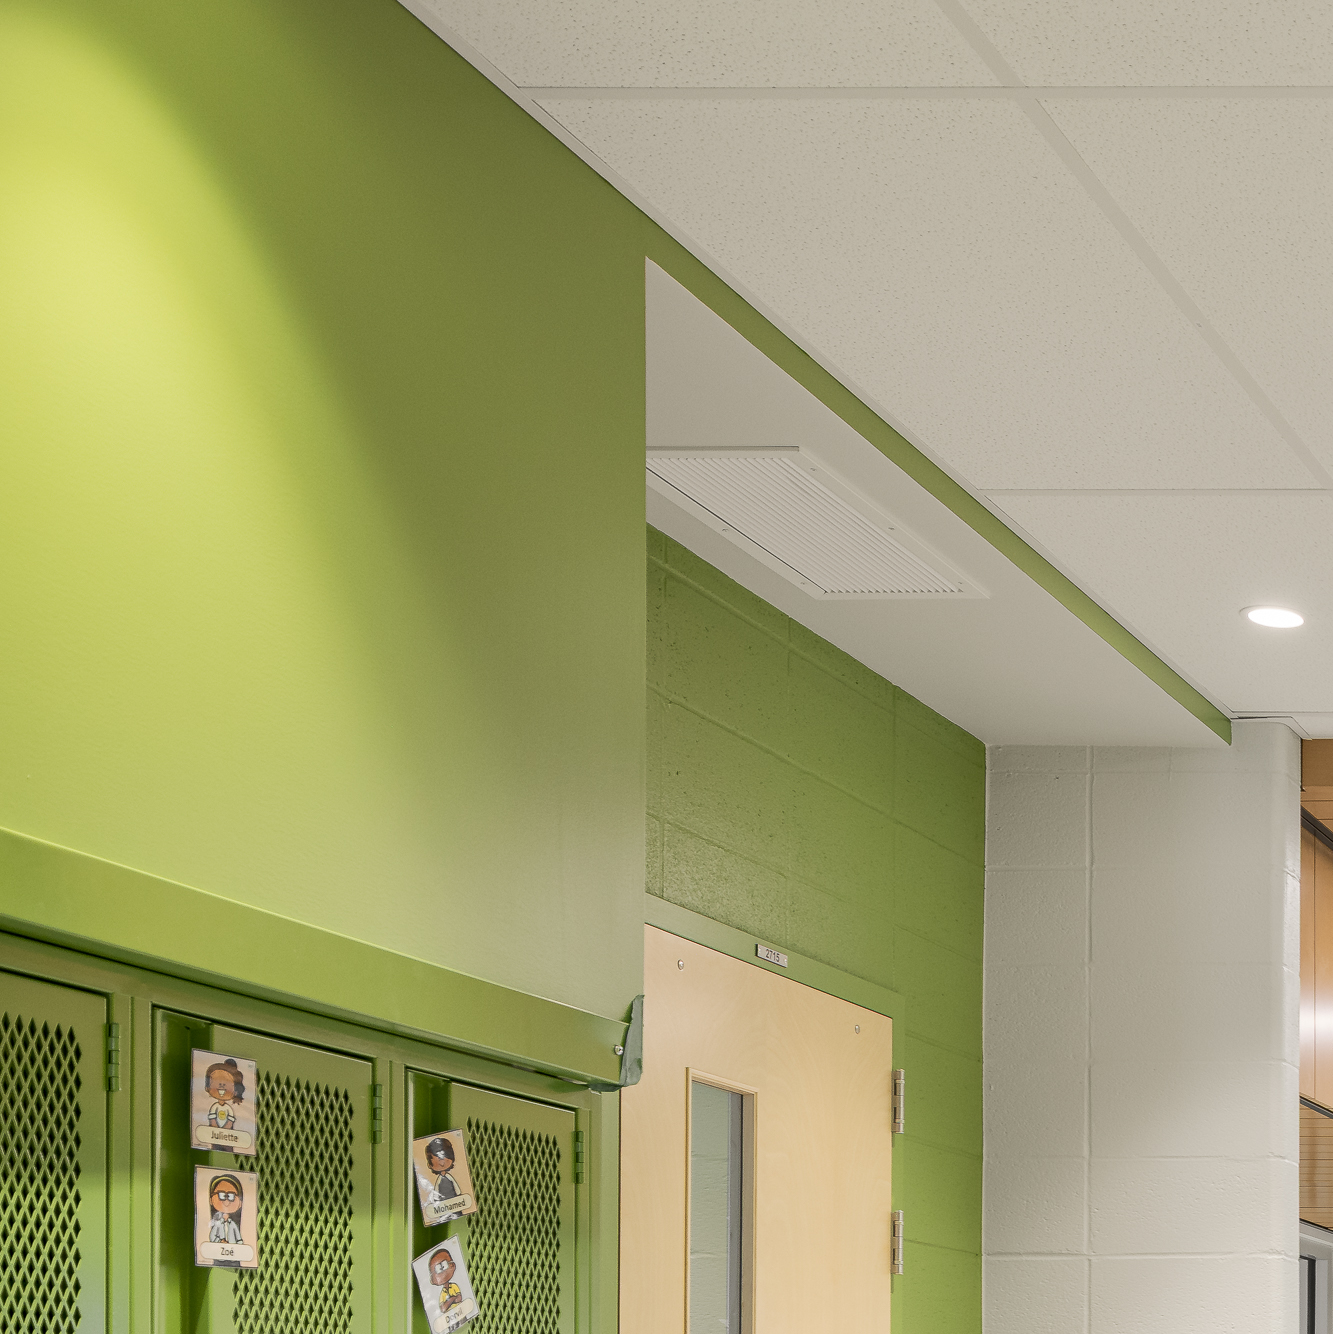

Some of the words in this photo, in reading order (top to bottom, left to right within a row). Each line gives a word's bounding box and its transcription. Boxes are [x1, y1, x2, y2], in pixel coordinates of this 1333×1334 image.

[766, 949, 780, 962] 2715
[211, 1131, 238, 1143] Juliette
[433, 1199, 466, 1214] Mohamed
[221, 1246, 234, 1256] Zoé
